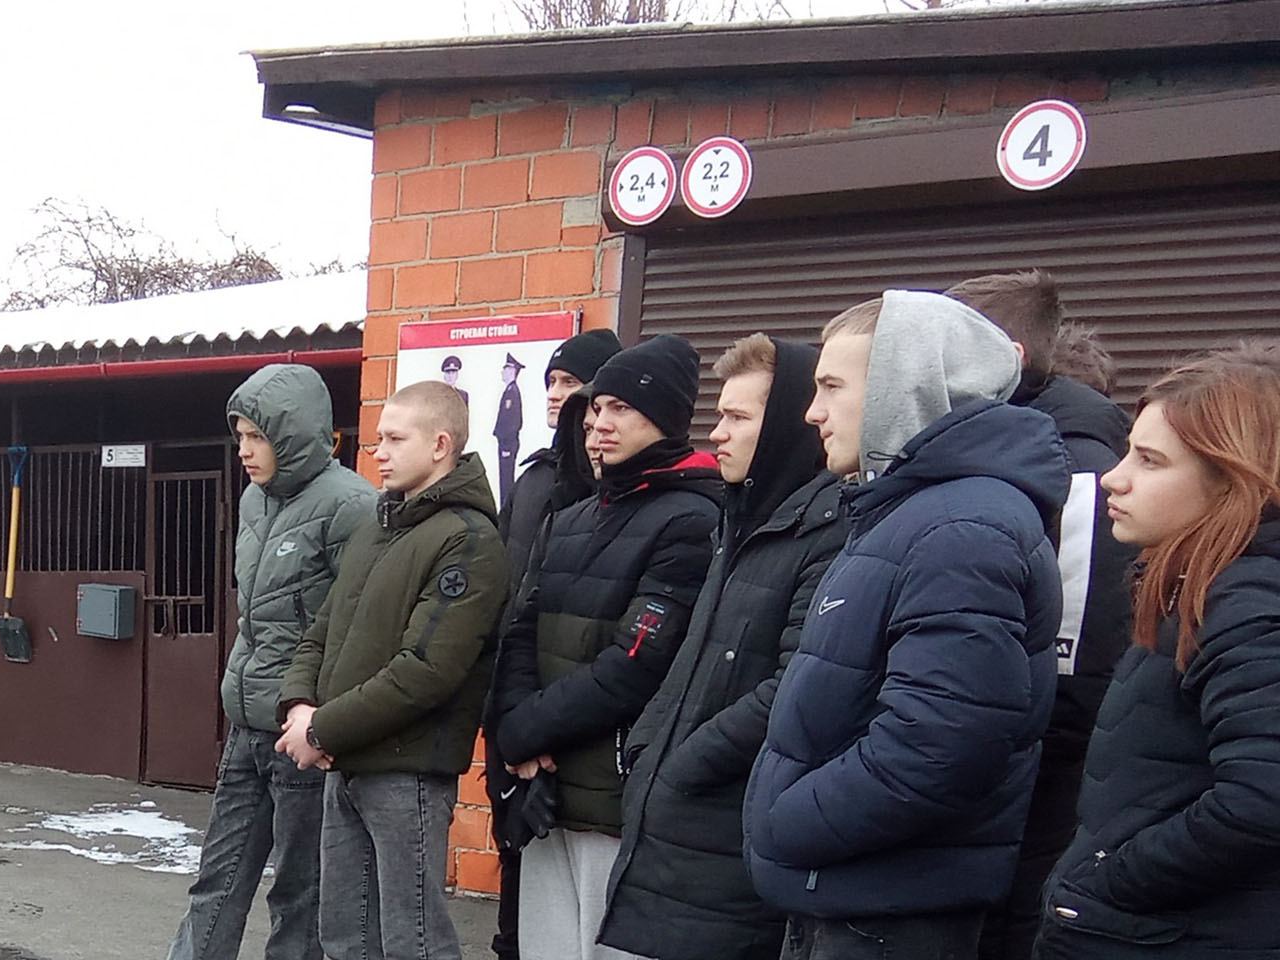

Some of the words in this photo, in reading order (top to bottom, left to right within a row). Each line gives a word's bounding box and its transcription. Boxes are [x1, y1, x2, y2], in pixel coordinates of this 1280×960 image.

[1023, 124, 1053, 167] 4
[702, 161, 730, 182] 2,2
[629, 172, 655, 193] 2,4
[450, 326, 487, 340] СТРОЕВАЯ
[488, 324, 518, 338] СТОЙКА
[106, 448, 114, 463] 5
